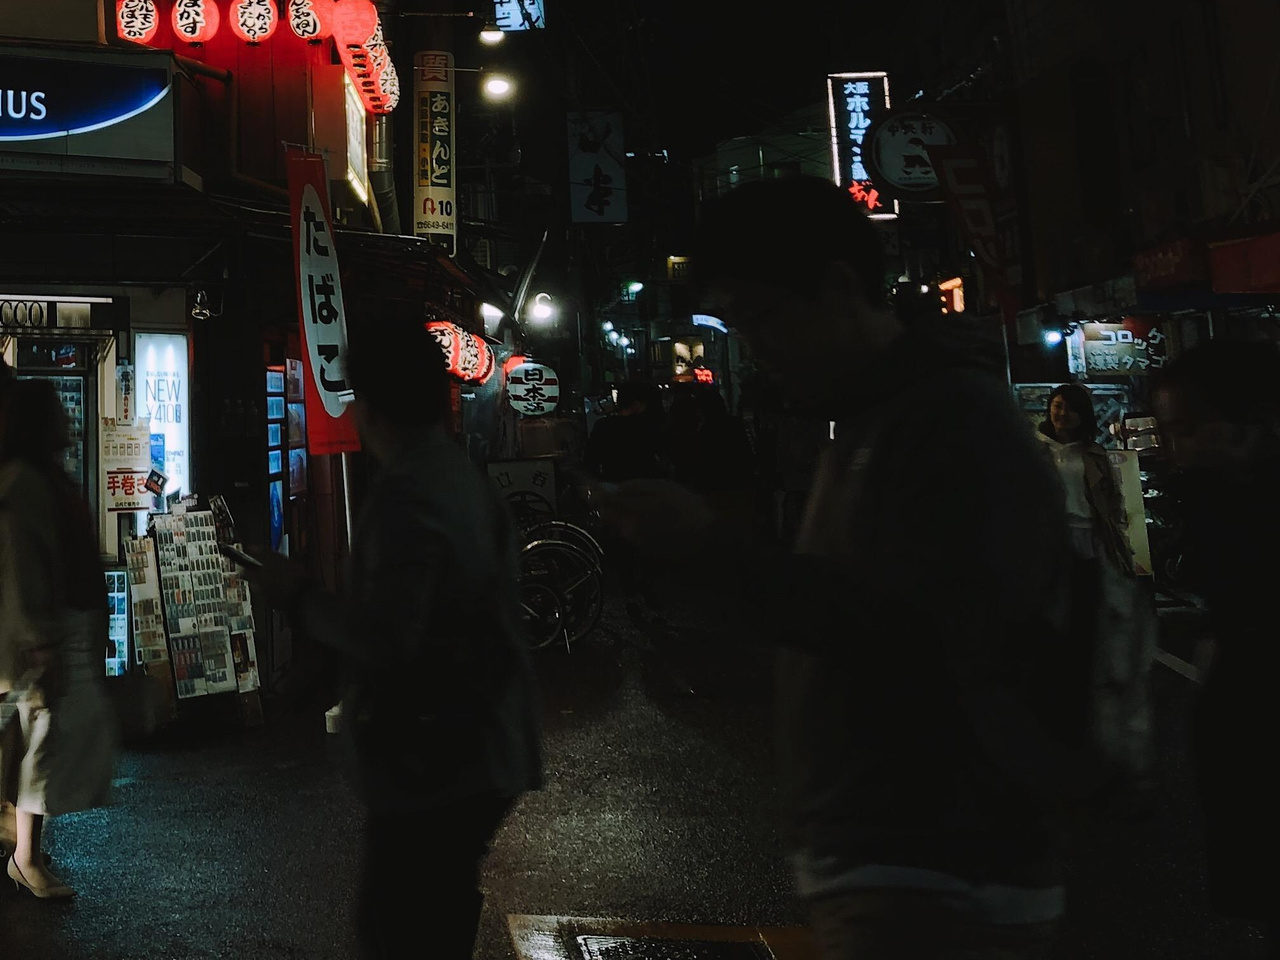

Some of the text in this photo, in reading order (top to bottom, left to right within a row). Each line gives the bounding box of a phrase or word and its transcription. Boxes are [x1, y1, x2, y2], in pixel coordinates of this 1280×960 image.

[423, 55, 447, 81] 質
[431, 93, 451, 184] あきんど
[438, 199, 453, 217] 10
[303, 205, 348, 393] たばこ
[145, 379, 181, 403] NEW
